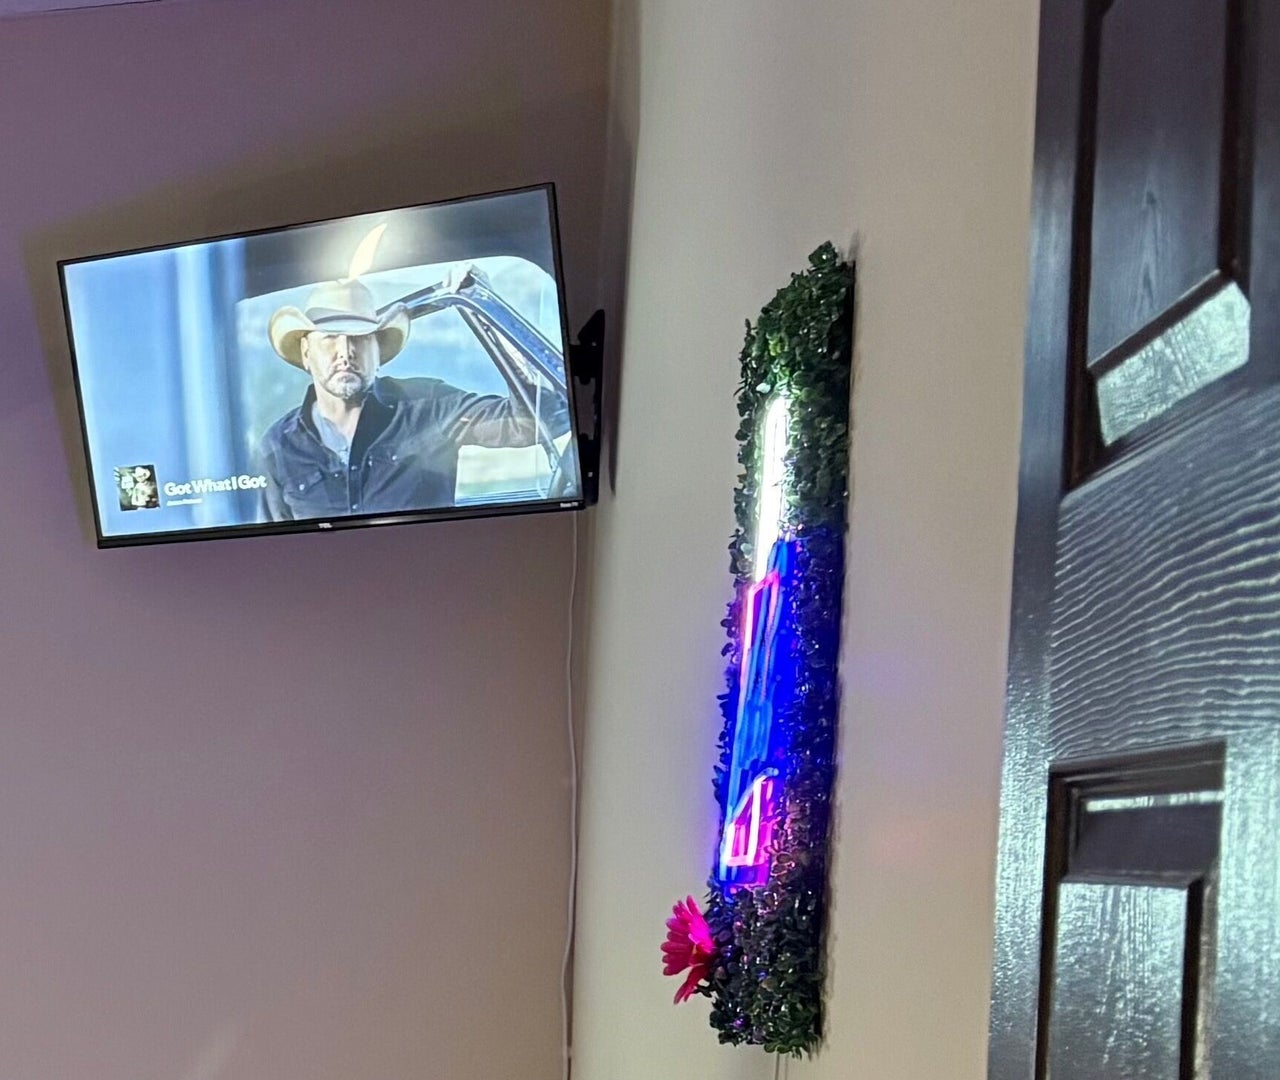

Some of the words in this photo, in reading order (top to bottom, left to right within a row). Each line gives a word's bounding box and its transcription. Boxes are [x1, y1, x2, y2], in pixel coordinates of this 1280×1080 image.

[164, 481, 192, 496] Got
[192, 478, 230, 494] What
[232, 476, 237, 490] I
[238, 474, 268, 490] Got
